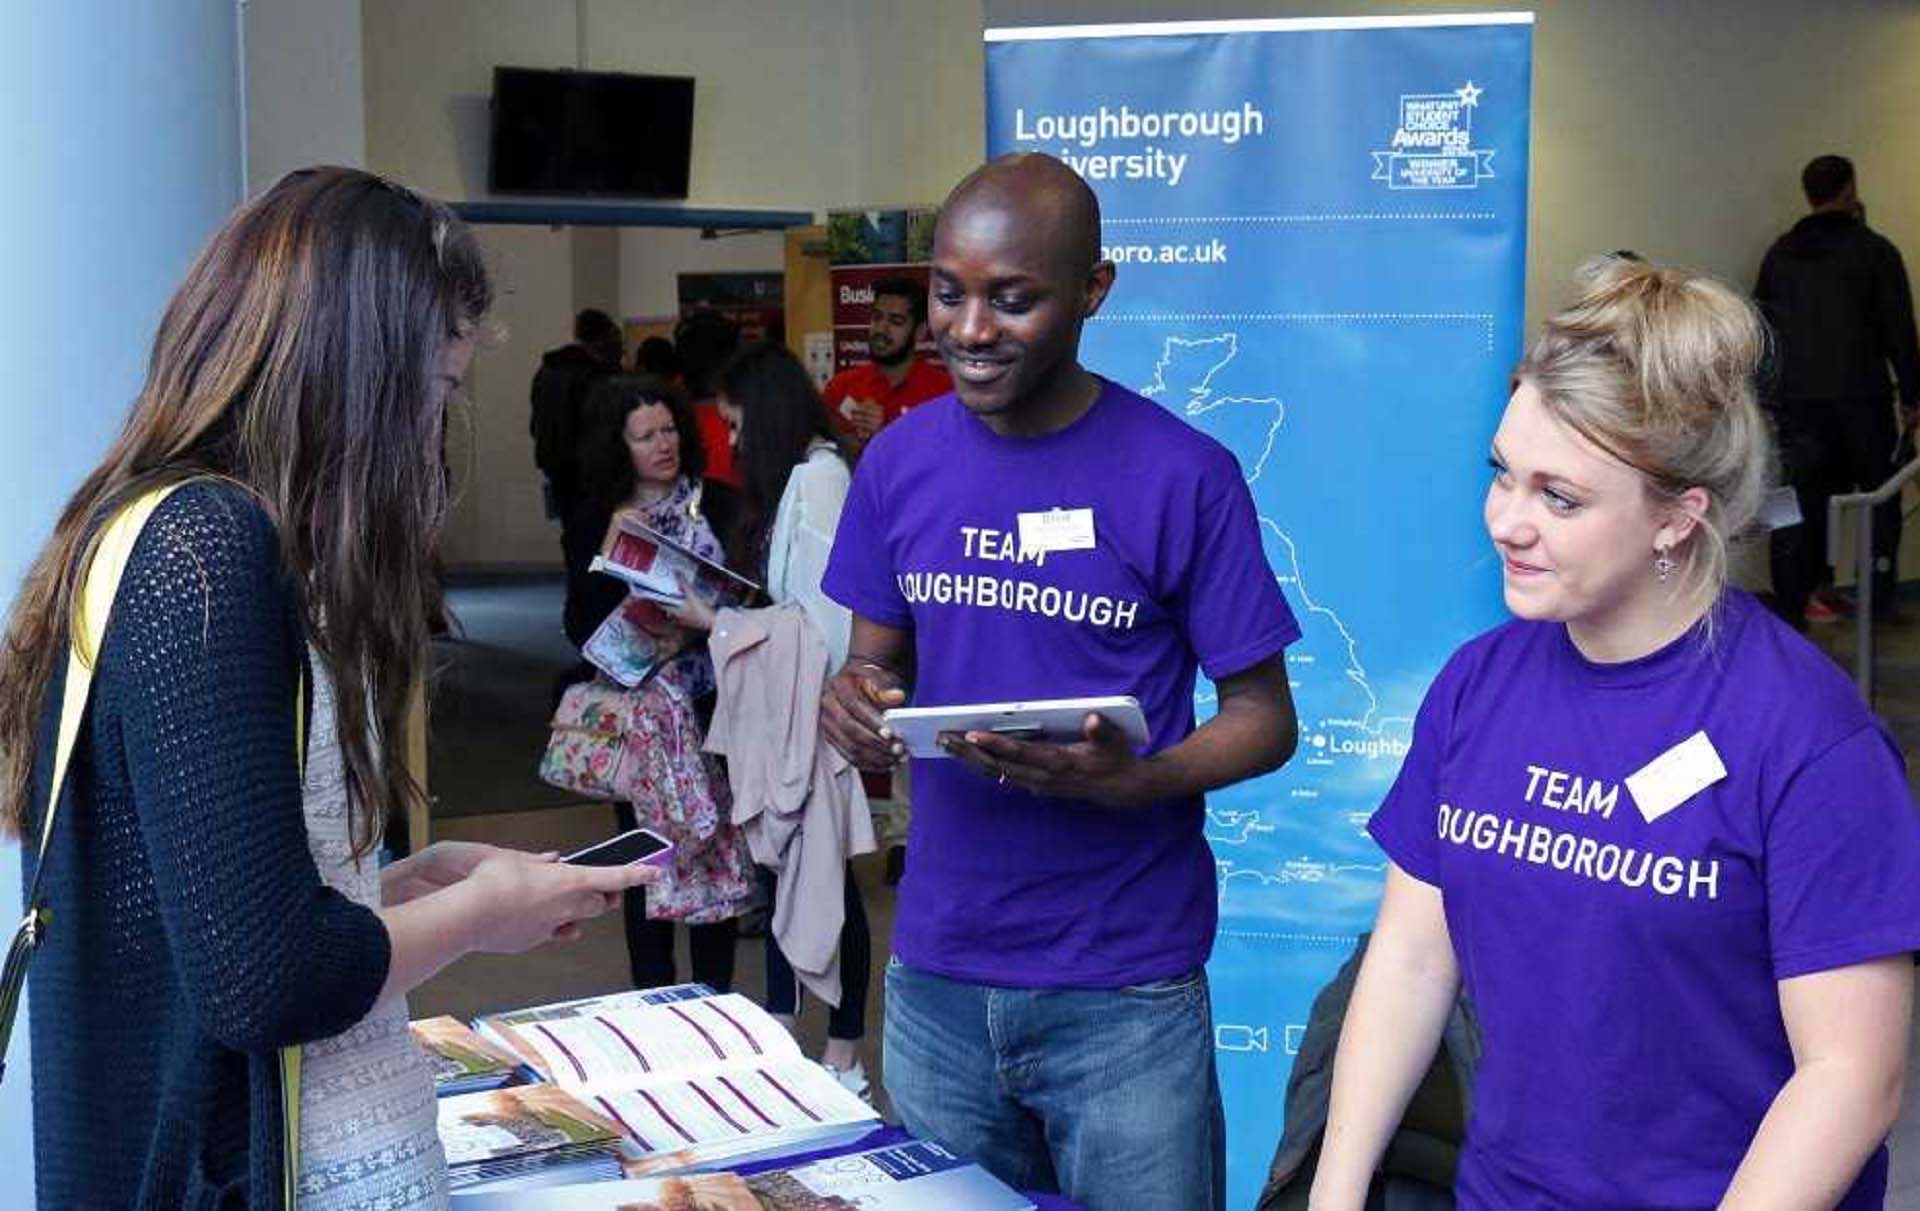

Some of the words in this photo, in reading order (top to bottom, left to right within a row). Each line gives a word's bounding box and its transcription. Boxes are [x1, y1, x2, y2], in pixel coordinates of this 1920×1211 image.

[1016, 102, 1263, 147] Loughborough
[1391, 127, 1470, 148] Awards
[1060, 147, 1187, 186] iversity
[1330, 734, 1409, 759] Loughb
[1524, 765, 1619, 820] TEAM
[1437, 804, 1719, 899] OUGHBOROUGH
